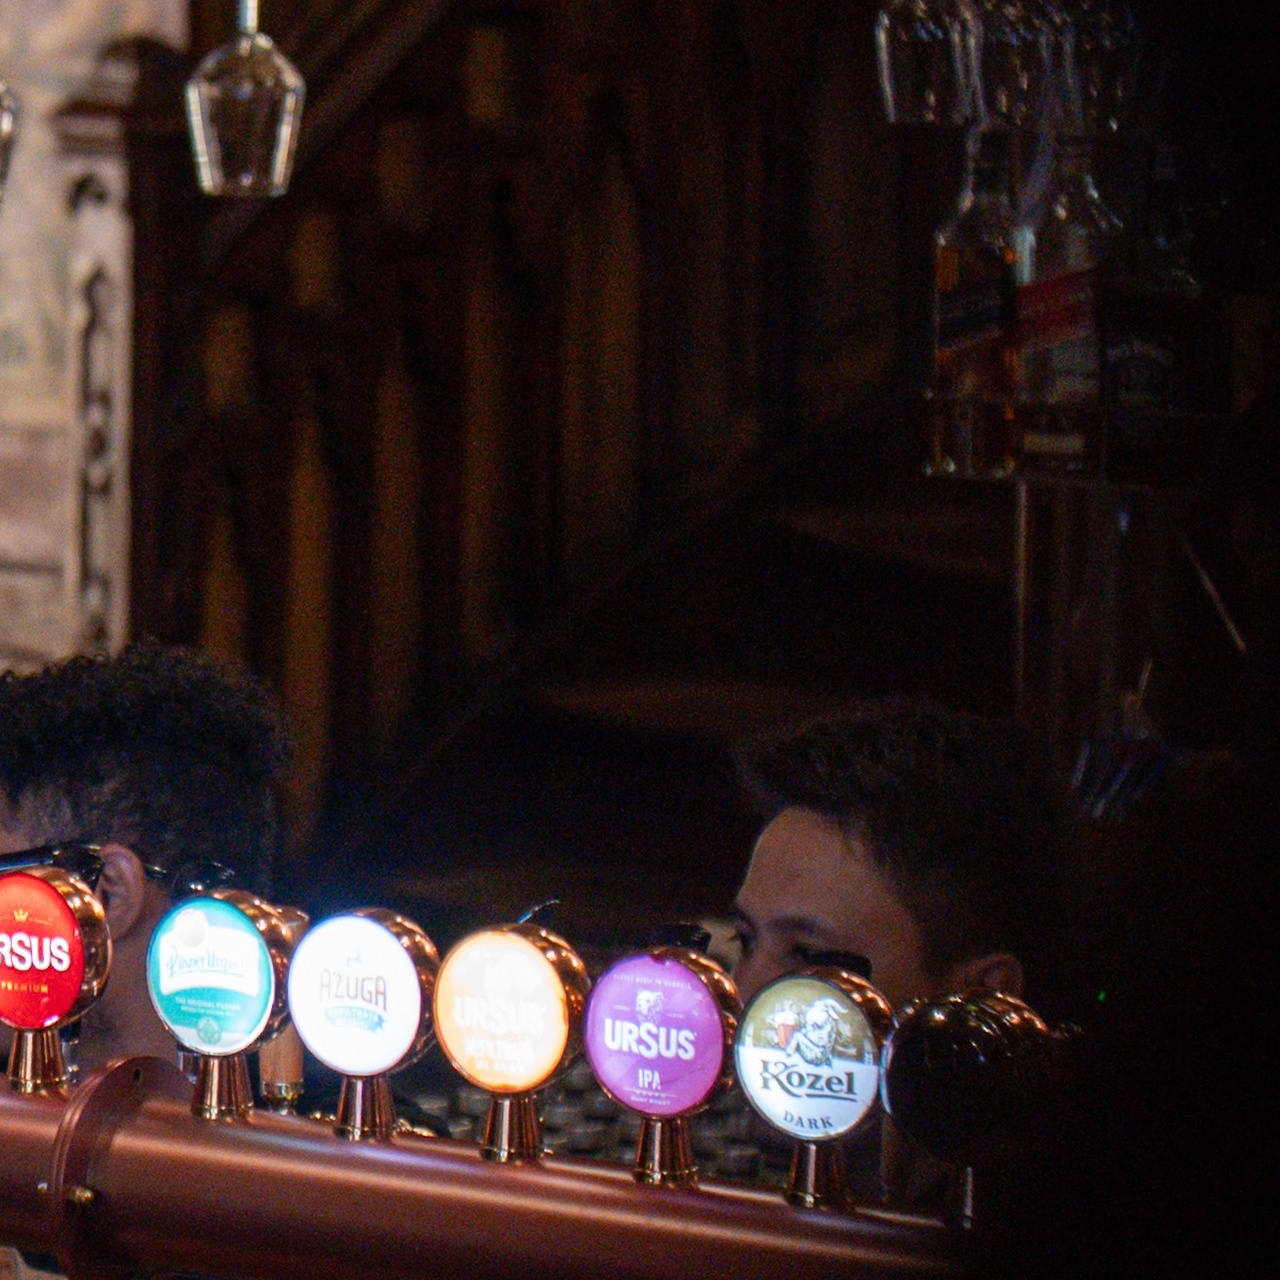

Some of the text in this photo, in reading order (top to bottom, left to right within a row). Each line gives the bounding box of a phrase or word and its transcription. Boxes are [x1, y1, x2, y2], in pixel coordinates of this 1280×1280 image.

[1, 981, 48, 993] PREMIUM
[320, 968, 387, 1012] AZUGA
[604, 1018, 696, 1060] URSUS
[638, 1069, 662, 1090] IPA
[761, 1060, 857, 1097] Kozel
[784, 1110, 834, 1129] DARK
